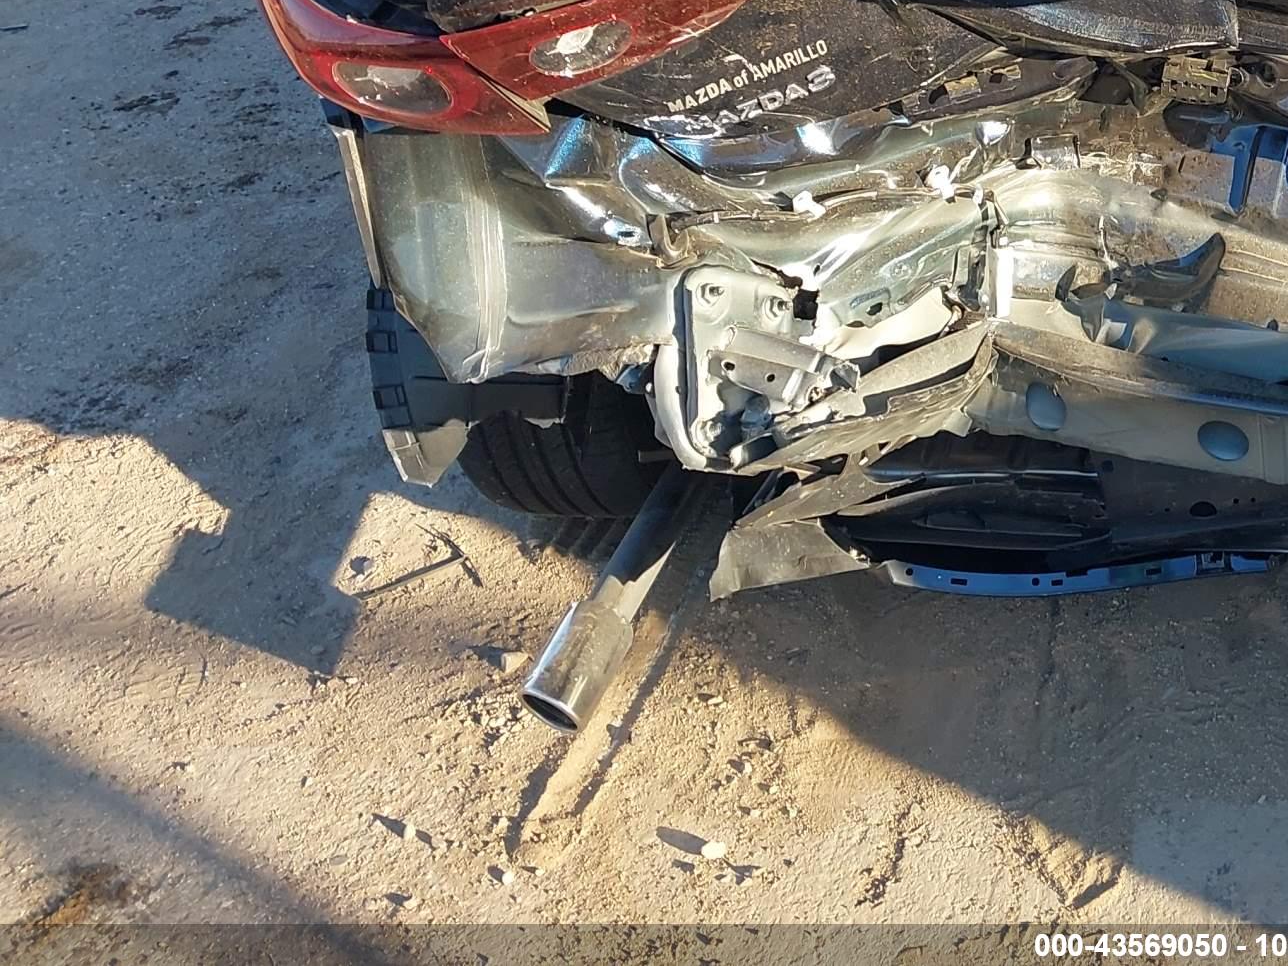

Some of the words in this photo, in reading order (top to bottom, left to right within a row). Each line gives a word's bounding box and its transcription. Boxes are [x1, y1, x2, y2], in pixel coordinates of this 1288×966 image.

[666, 78, 732, 113] MAZDA
[733, 69, 749, 88] of
[750, 39, 828, 81] AMARILLO
